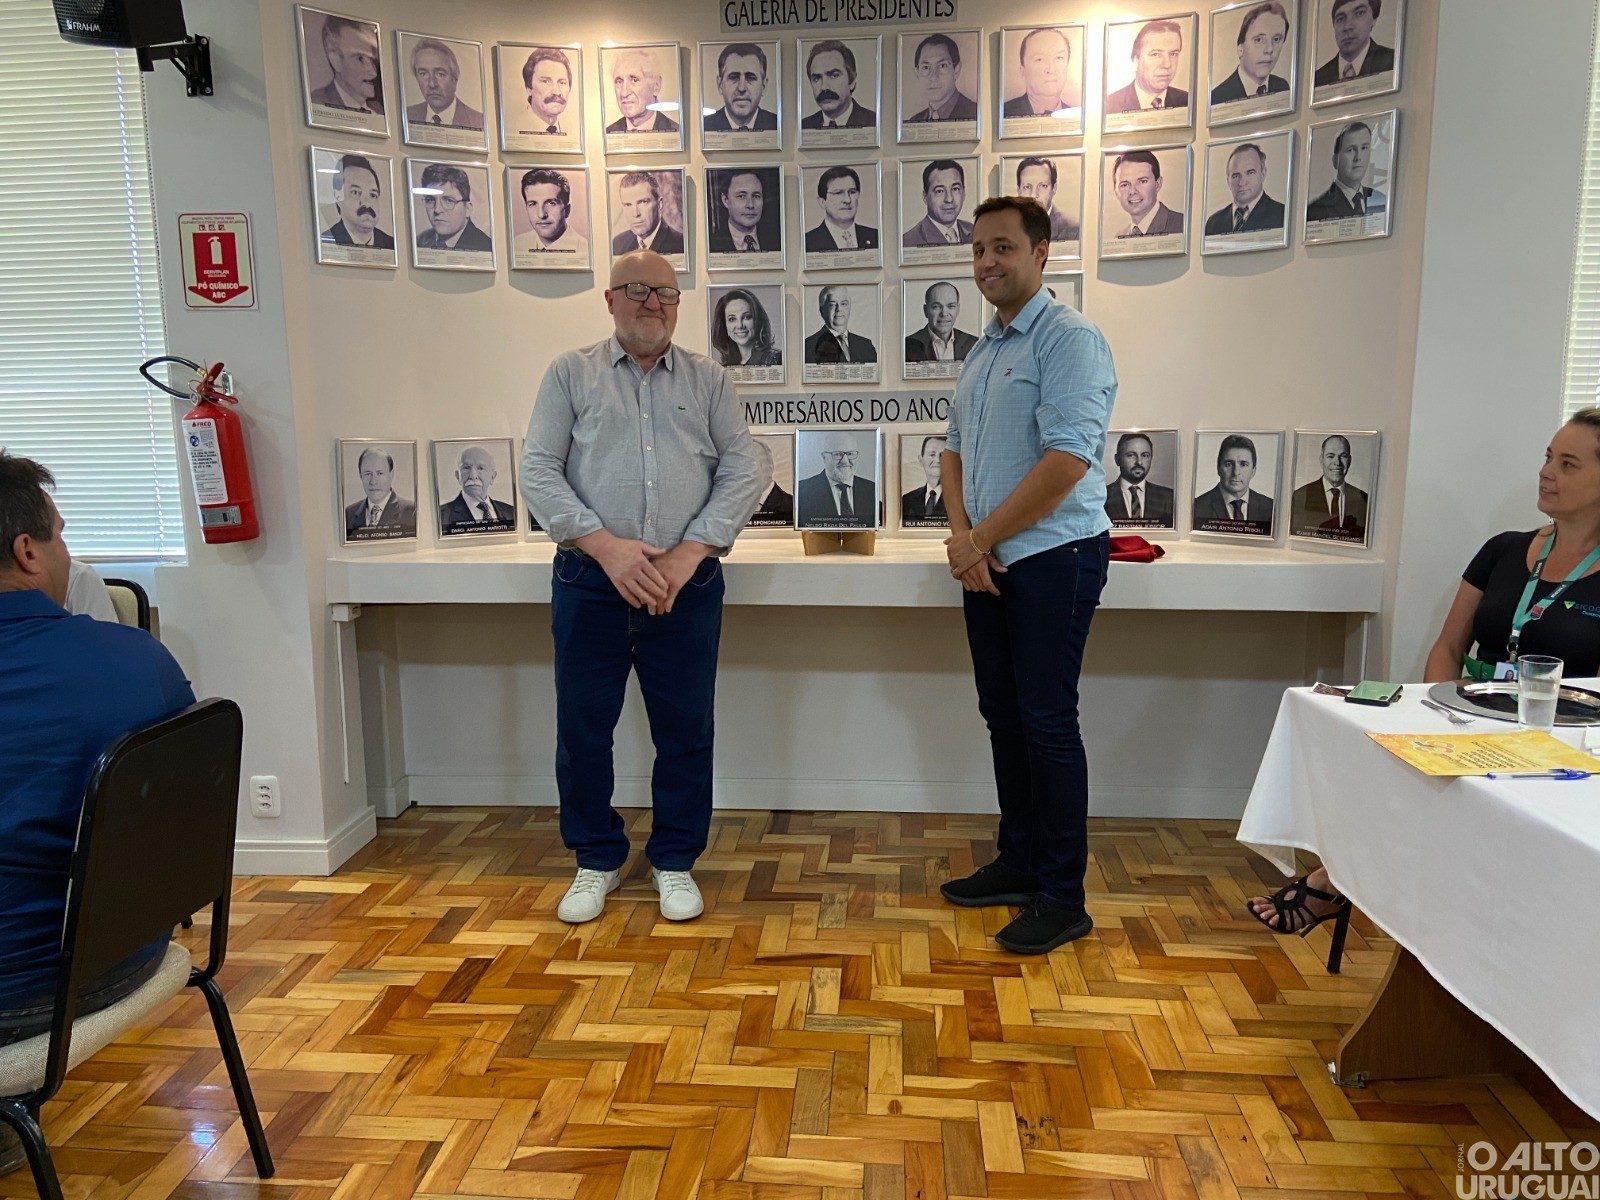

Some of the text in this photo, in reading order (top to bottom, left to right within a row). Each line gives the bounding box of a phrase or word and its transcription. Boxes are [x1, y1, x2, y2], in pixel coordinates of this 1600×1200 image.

[724, 0, 955, 27] GALERIA DE PRESIDENTES
[72, 21, 101, 32] FRAHM
[198, 281, 239, 290] PÓ QUÍMICO
[212, 291, 226, 299] ABC
[740, 393, 951, 424] MPRESÁRIOS DO ANO
